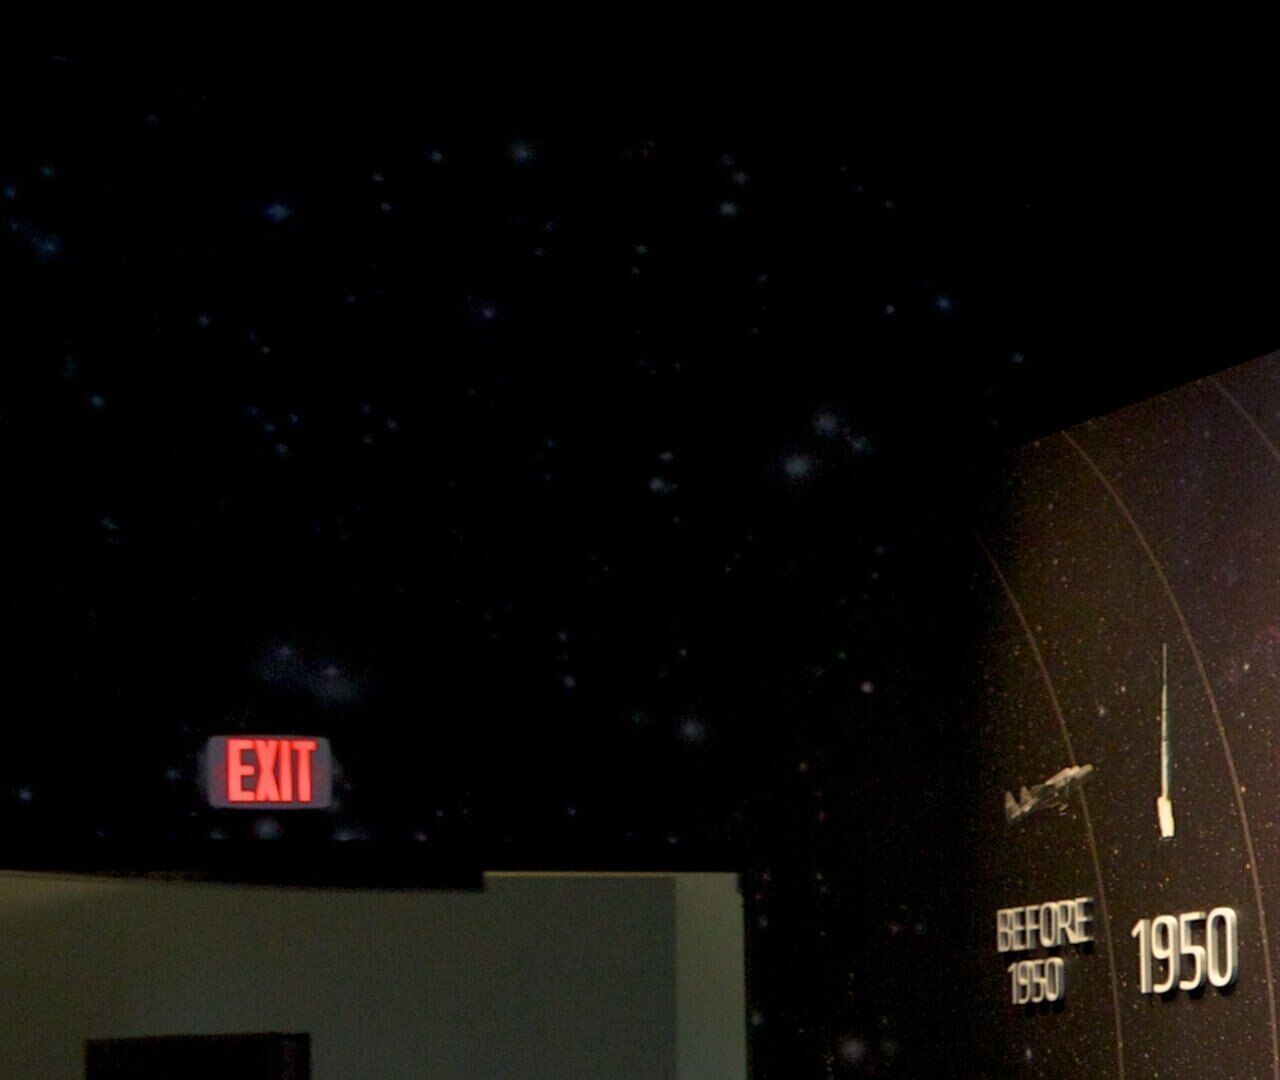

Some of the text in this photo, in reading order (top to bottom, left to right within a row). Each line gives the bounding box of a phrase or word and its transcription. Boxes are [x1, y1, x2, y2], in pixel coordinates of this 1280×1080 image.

[227, 739, 318, 803] EXIT
[996, 897, 1094, 954] BEFORE
[1131, 906, 1239, 995] 1950
[1007, 957, 1064, 1005] 1950
